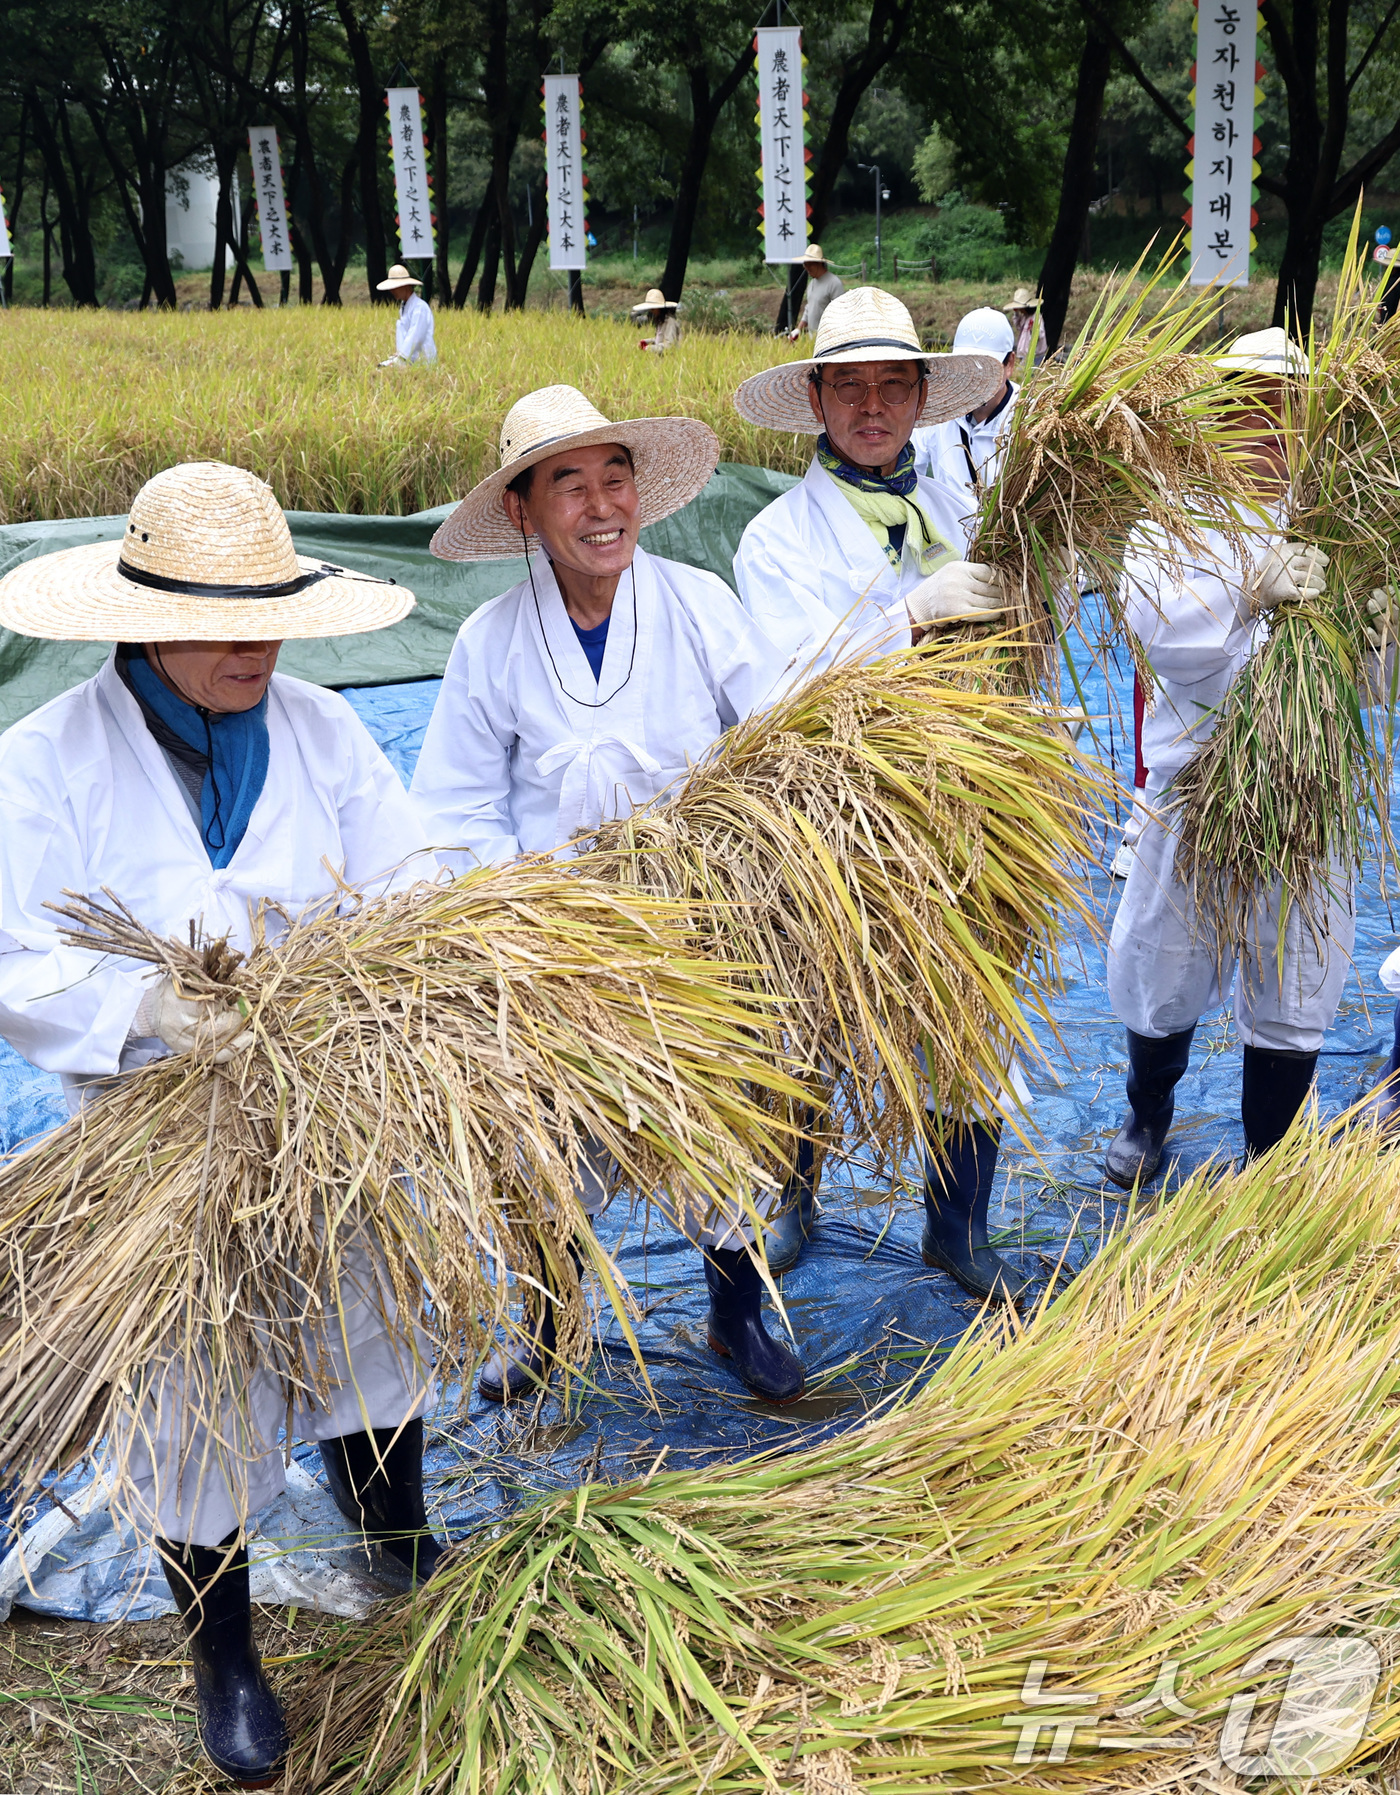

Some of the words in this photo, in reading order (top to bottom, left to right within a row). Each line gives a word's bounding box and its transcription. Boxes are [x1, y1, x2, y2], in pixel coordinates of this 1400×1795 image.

[257, 138, 284, 256] 農者天下之大本
[399, 103, 423, 242] 農者天下之大本
[555, 92, 575, 252] 農者天下之大本
[771, 48, 795, 242] 農者天下之大本
[1207, 4, 1241, 259] 농자천하지대본
